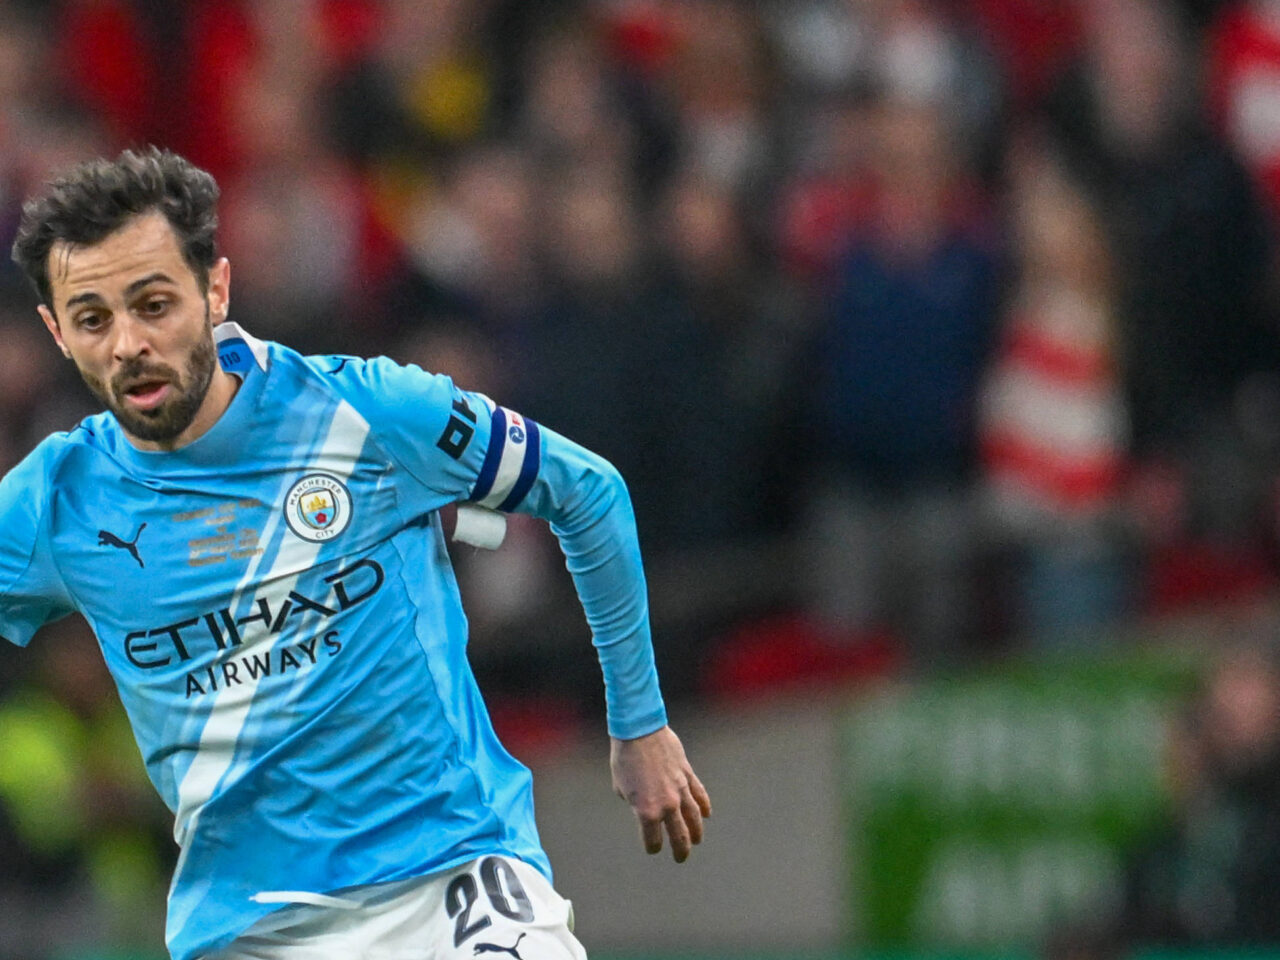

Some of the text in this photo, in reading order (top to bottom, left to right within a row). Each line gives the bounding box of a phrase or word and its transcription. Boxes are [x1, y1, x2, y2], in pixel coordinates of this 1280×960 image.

[290, 479, 342, 505] MANCHESTER
[315, 529, 334, 539] CITY
[124, 559, 385, 669] ETIHAD
[185, 630, 342, 698] AIRWAYS
[445, 856, 535, 948] 20
